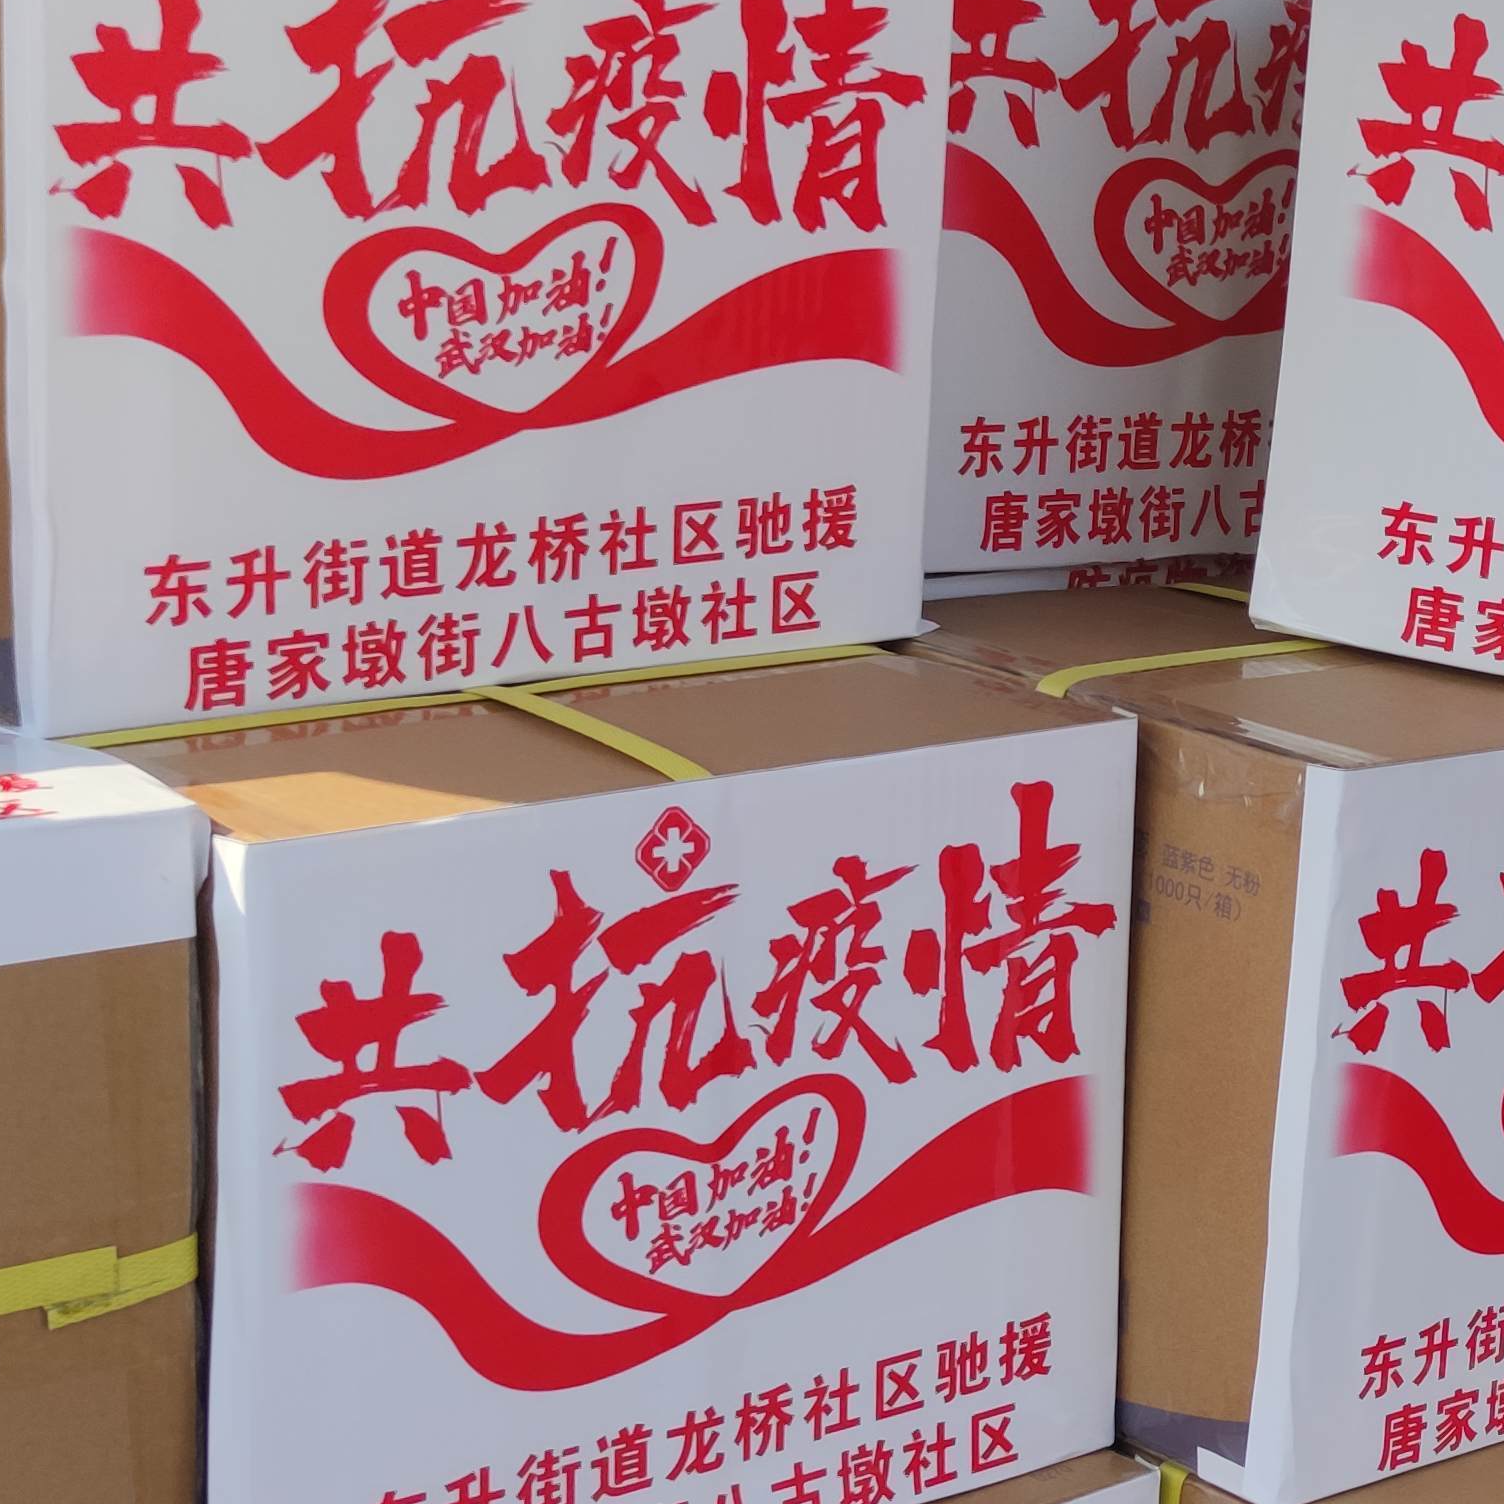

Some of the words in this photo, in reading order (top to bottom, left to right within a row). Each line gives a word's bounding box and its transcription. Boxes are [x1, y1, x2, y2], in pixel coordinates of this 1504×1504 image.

[961, 410, 1271, 477] 东升街道龙桥
[144, 484, 856, 627] 东升街道龙桥社区驰援
[184, 571, 820, 710] 唐家墩街八古墩社区
[273, 779, 1117, 1172] 共抗疫情
